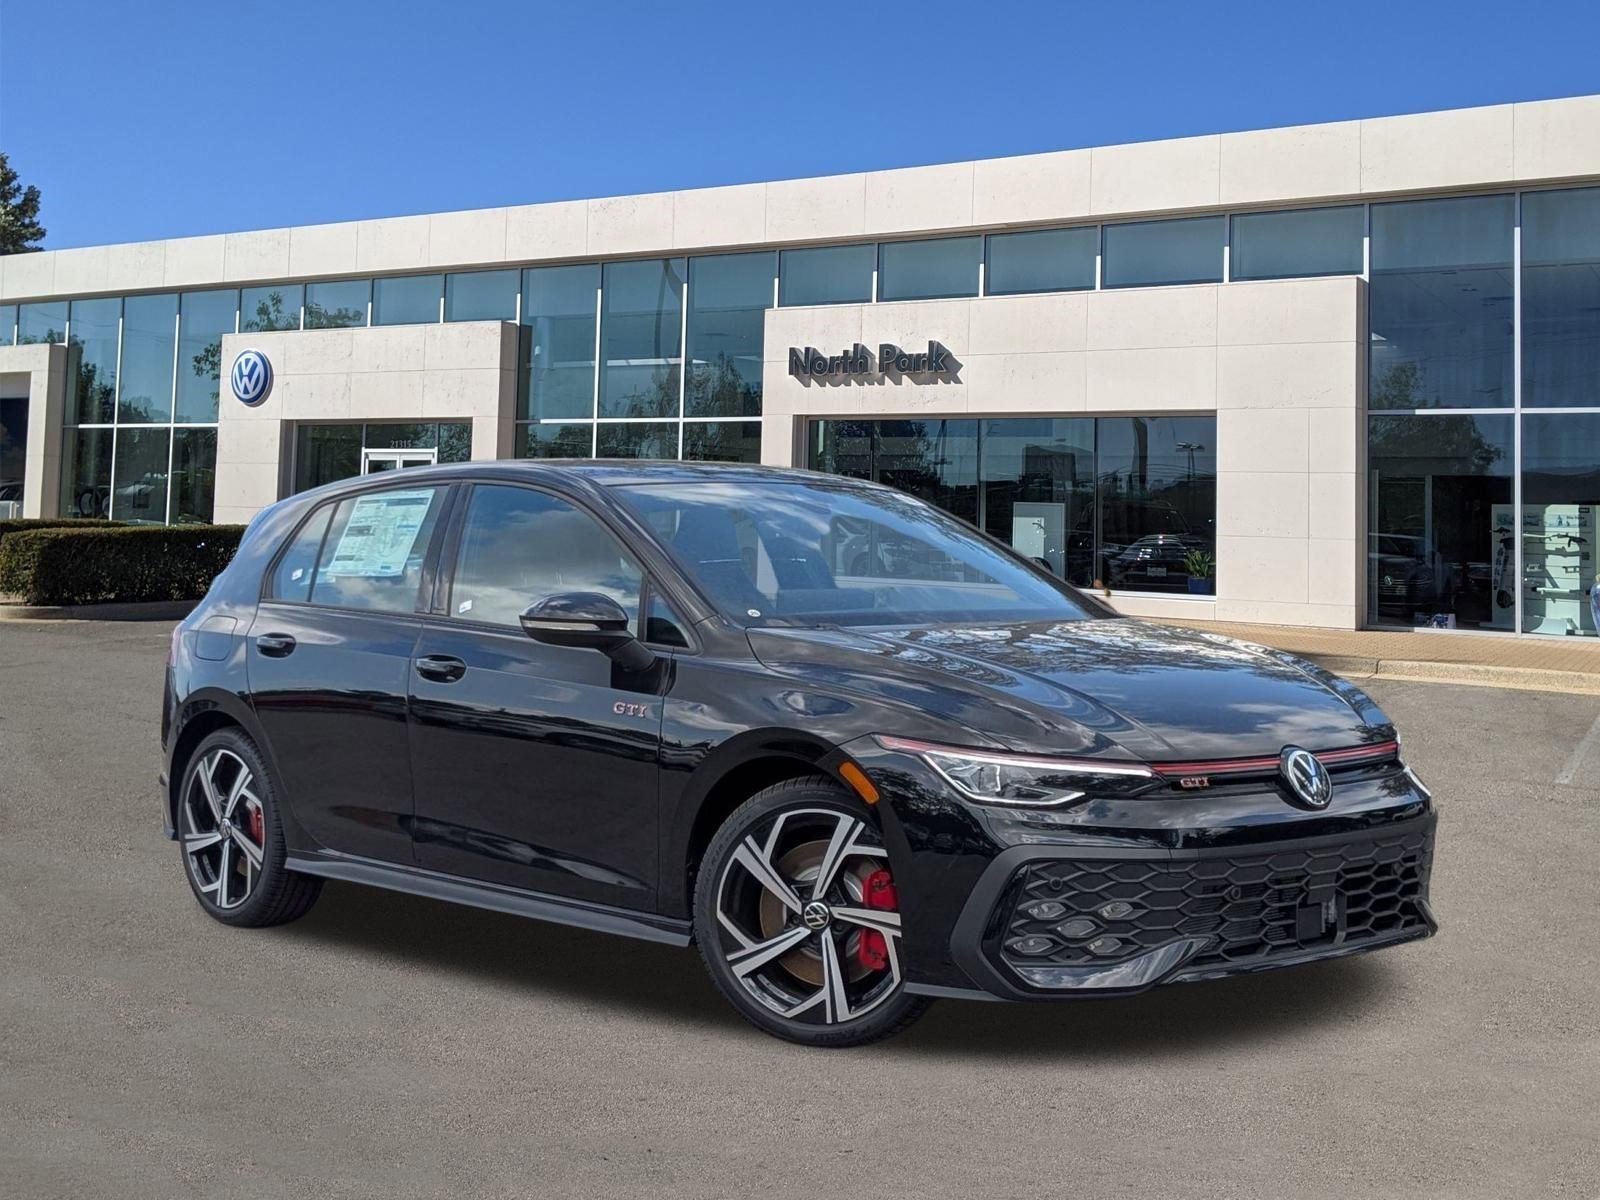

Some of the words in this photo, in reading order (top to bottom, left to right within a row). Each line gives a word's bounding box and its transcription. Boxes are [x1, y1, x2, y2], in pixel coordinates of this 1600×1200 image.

[788, 343, 871, 376] North
[878, 340, 949, 374] Park
[232, 351, 268, 402] VW
[613, 701, 647, 718] GTI
[1180, 776, 1209, 788] GTI
[1288, 750, 1332, 805] VW
